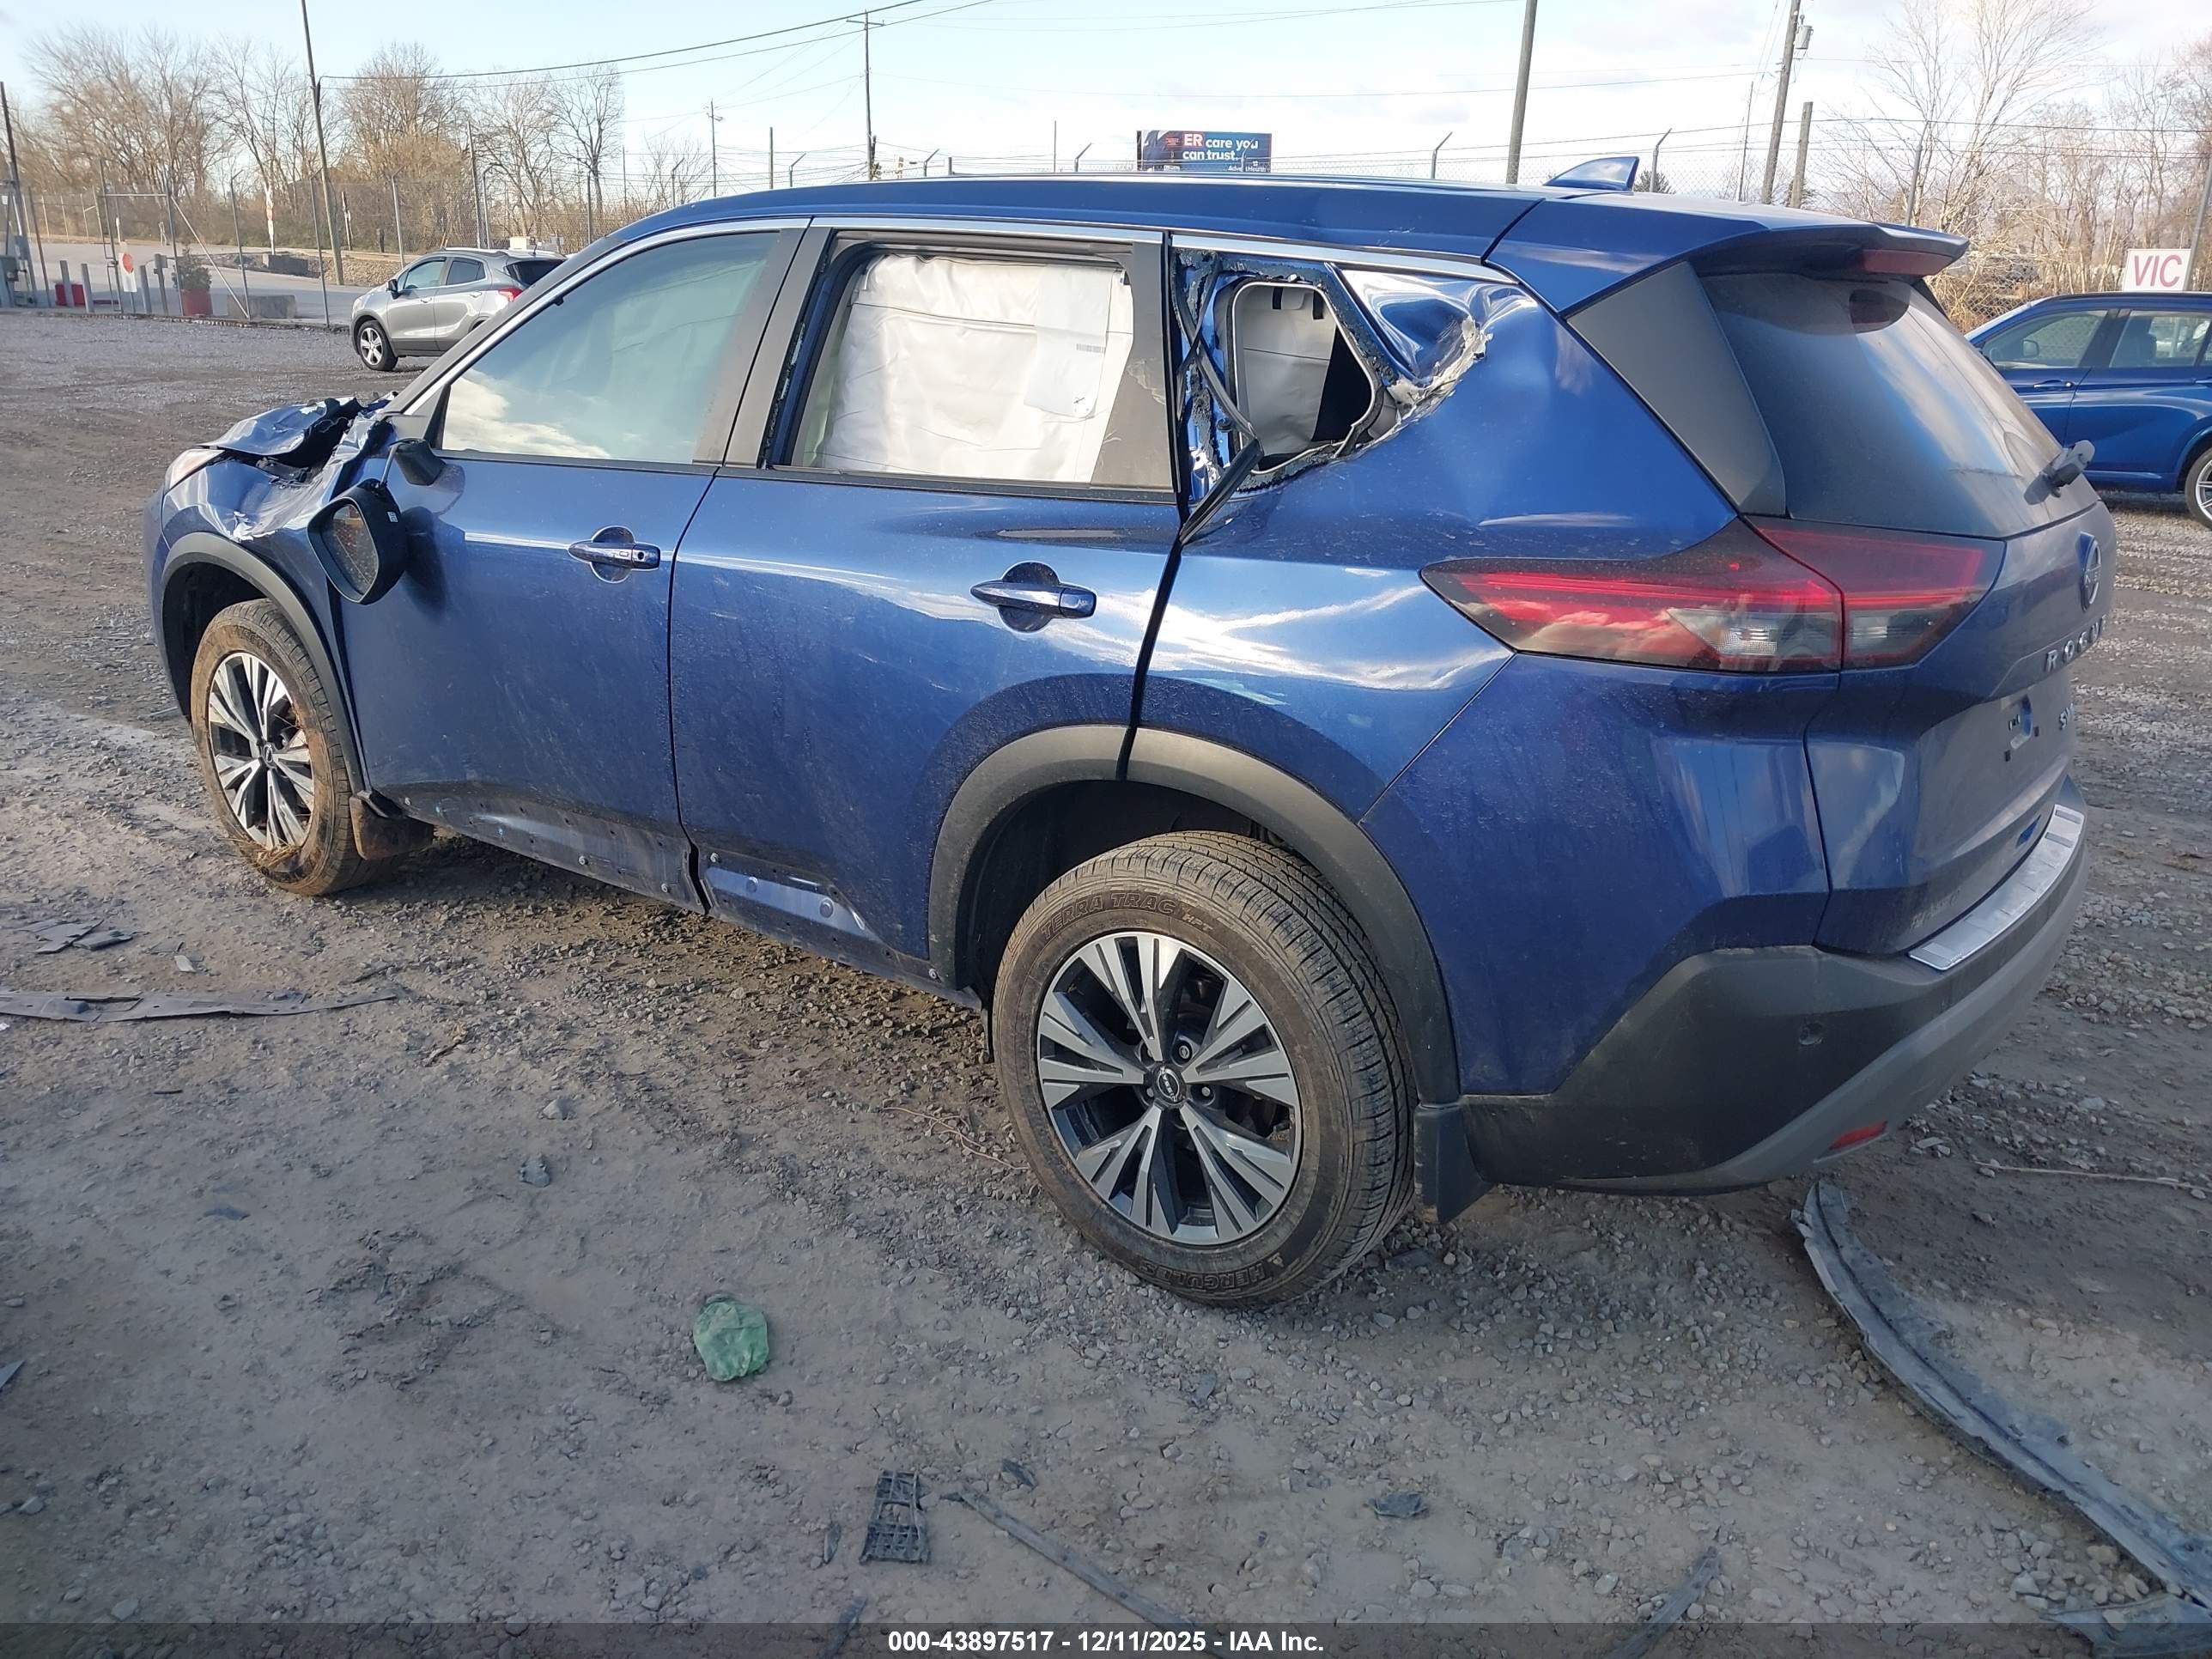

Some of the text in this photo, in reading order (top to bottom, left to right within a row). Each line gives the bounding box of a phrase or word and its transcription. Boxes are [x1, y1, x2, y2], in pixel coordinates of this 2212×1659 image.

[1182, 149, 1238, 161] can trust.
[1184, 133, 1259, 152] ER care you
[2134, 254, 2182, 288] VIC
[1041, 894, 1103, 939] TERRA
[1111, 892, 1176, 915] TRAC
[1139, 1260, 1267, 1290] HERCULES
